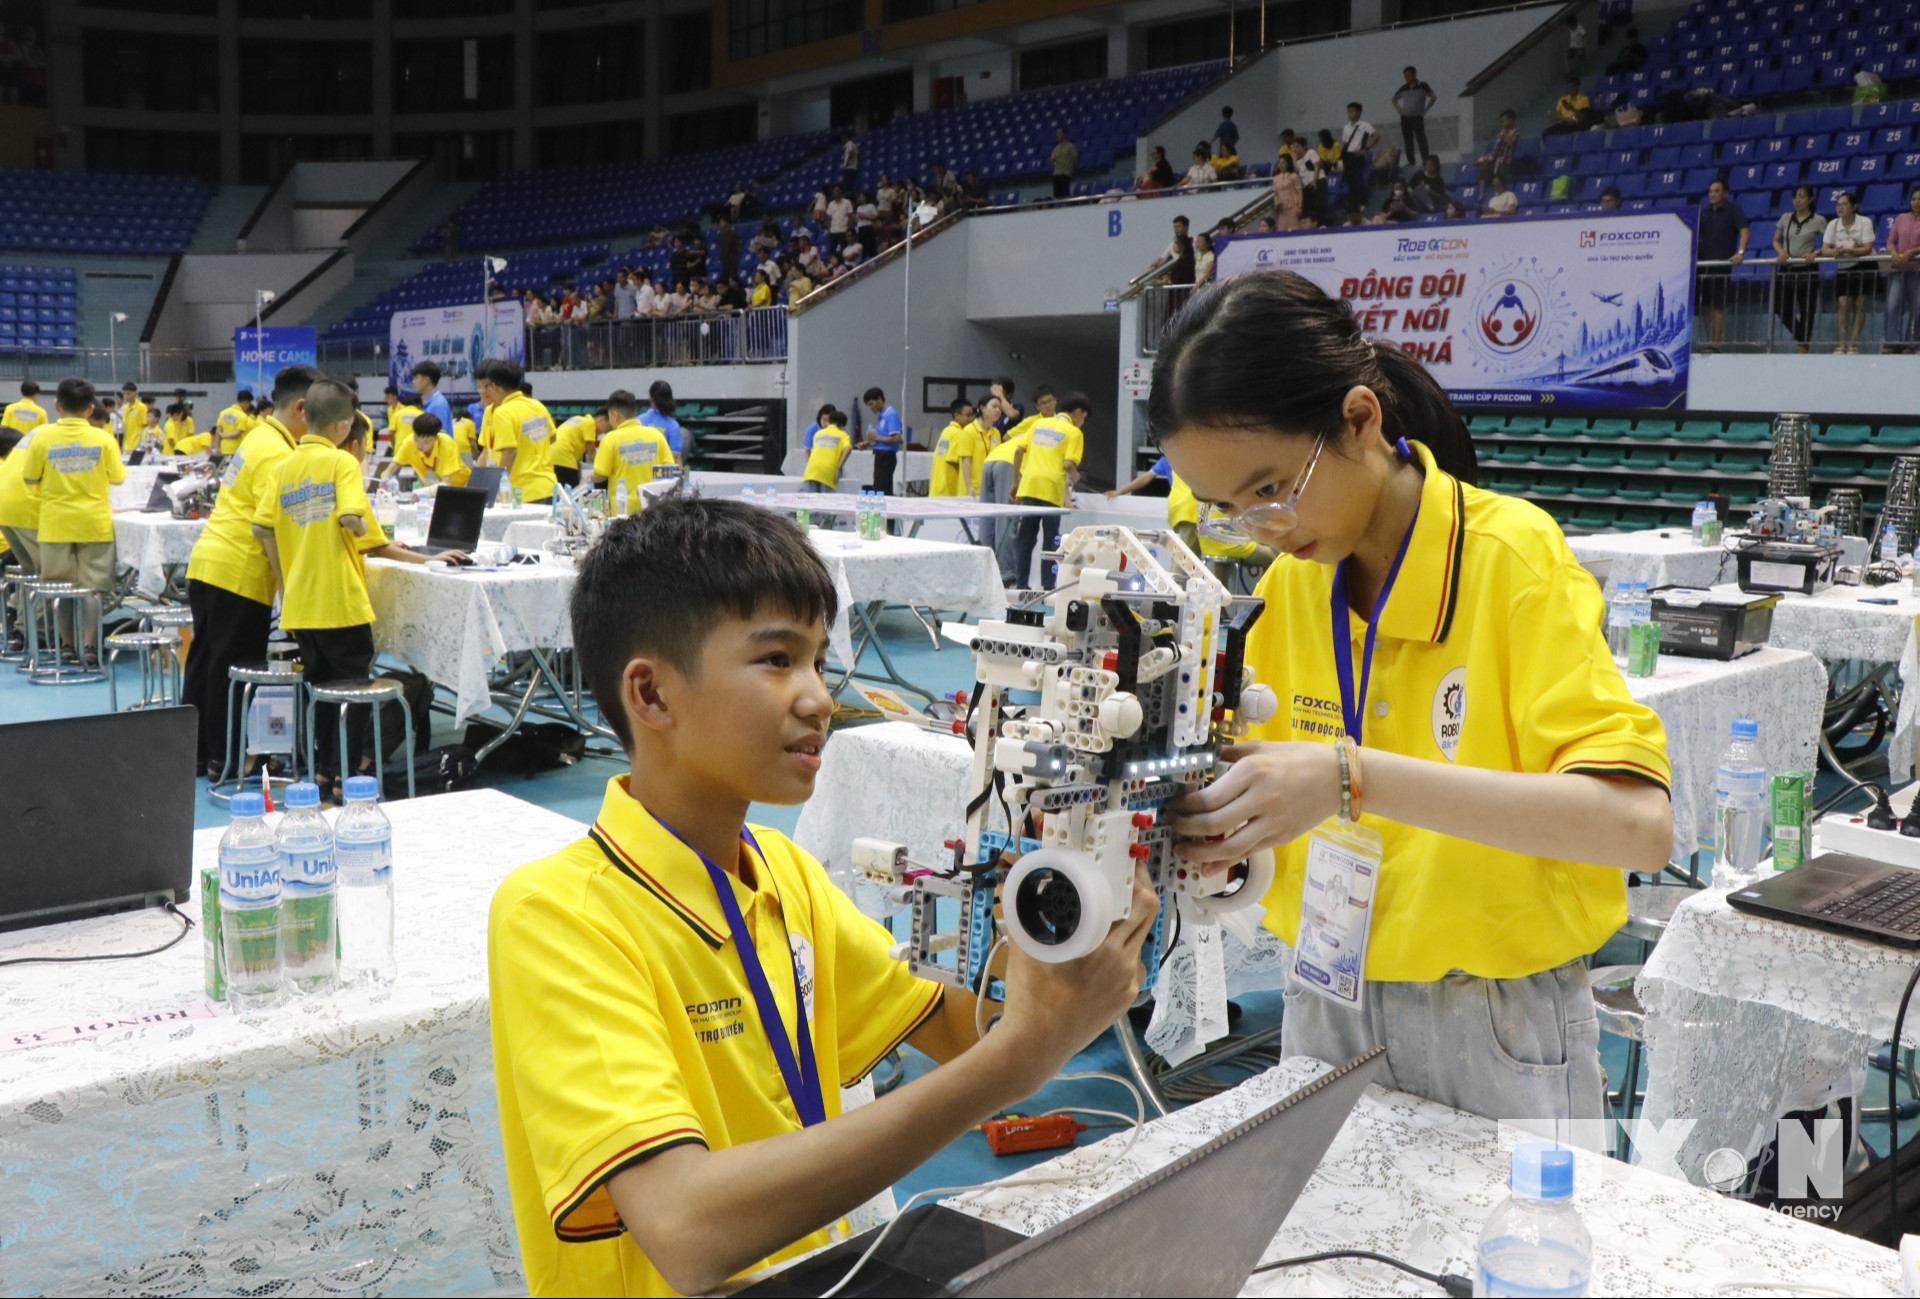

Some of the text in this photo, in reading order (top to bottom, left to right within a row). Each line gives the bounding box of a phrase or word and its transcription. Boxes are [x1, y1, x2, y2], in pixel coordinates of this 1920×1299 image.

[1905, 59, 1917, 69] 21
[1834, 67, 1845, 77] 17
[1846, 135, 1860, 146] 23
[1886, 131, 1901, 142] 25
[1806, 138, 1815, 149] 2
[1735, 144, 1747, 155] 17
[1861, 159, 1876, 171] 25
[1905, 154, 1920, 166] 27
[1776, 166, 1786, 176] 2
[1108, 210, 1122, 237] B
[1600, 231, 1660, 241] FOXCONN
[1341, 268, 1466, 301] ĐỒNG ĐỘI
[1402, 299, 1450, 331] NỐI
[241, 350, 276, 362] HOME
[1449, 393, 1474, 401] TRANH
[1493, 393, 1532, 402] FOXCONN
[1293, 694, 1342, 714] FOXCON
[1300, 719, 1316, 735] TRỢ
[1318, 722, 1333, 737] ĐỘC
[700, 1027, 720, 1044] TRỢ
